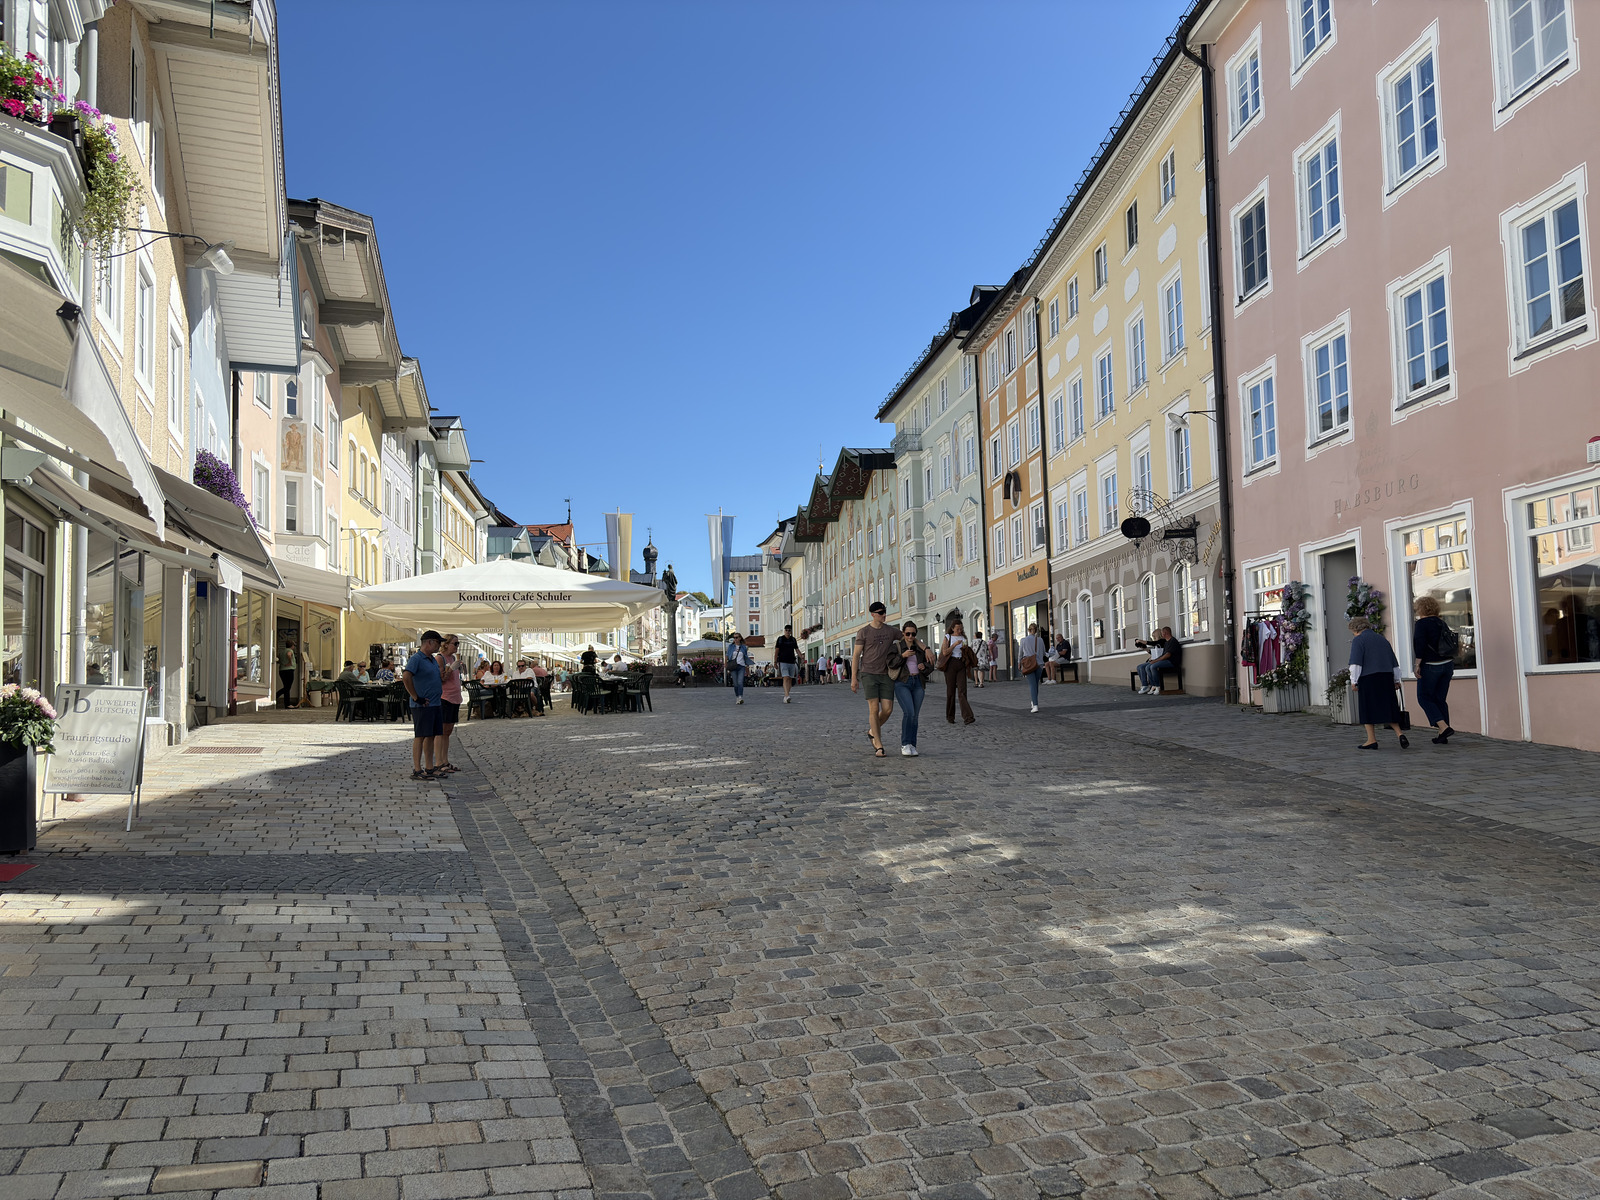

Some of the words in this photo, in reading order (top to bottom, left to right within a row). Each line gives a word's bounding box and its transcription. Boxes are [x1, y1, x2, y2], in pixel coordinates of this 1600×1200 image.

[1333, 474, 1419, 514] HABSBURG
[459, 592, 510, 602] Konditorei
[512, 591, 535, 602] Café
[536, 591, 572, 602] Schuler
[59, 689, 91, 720] jb
[95, 699, 137, 707] JUWELIER
[94, 707, 138, 715] BUTSCHAL
[60, 731, 131, 745] Trauringstudio
[69, 749, 110, 757] Marktstraße
